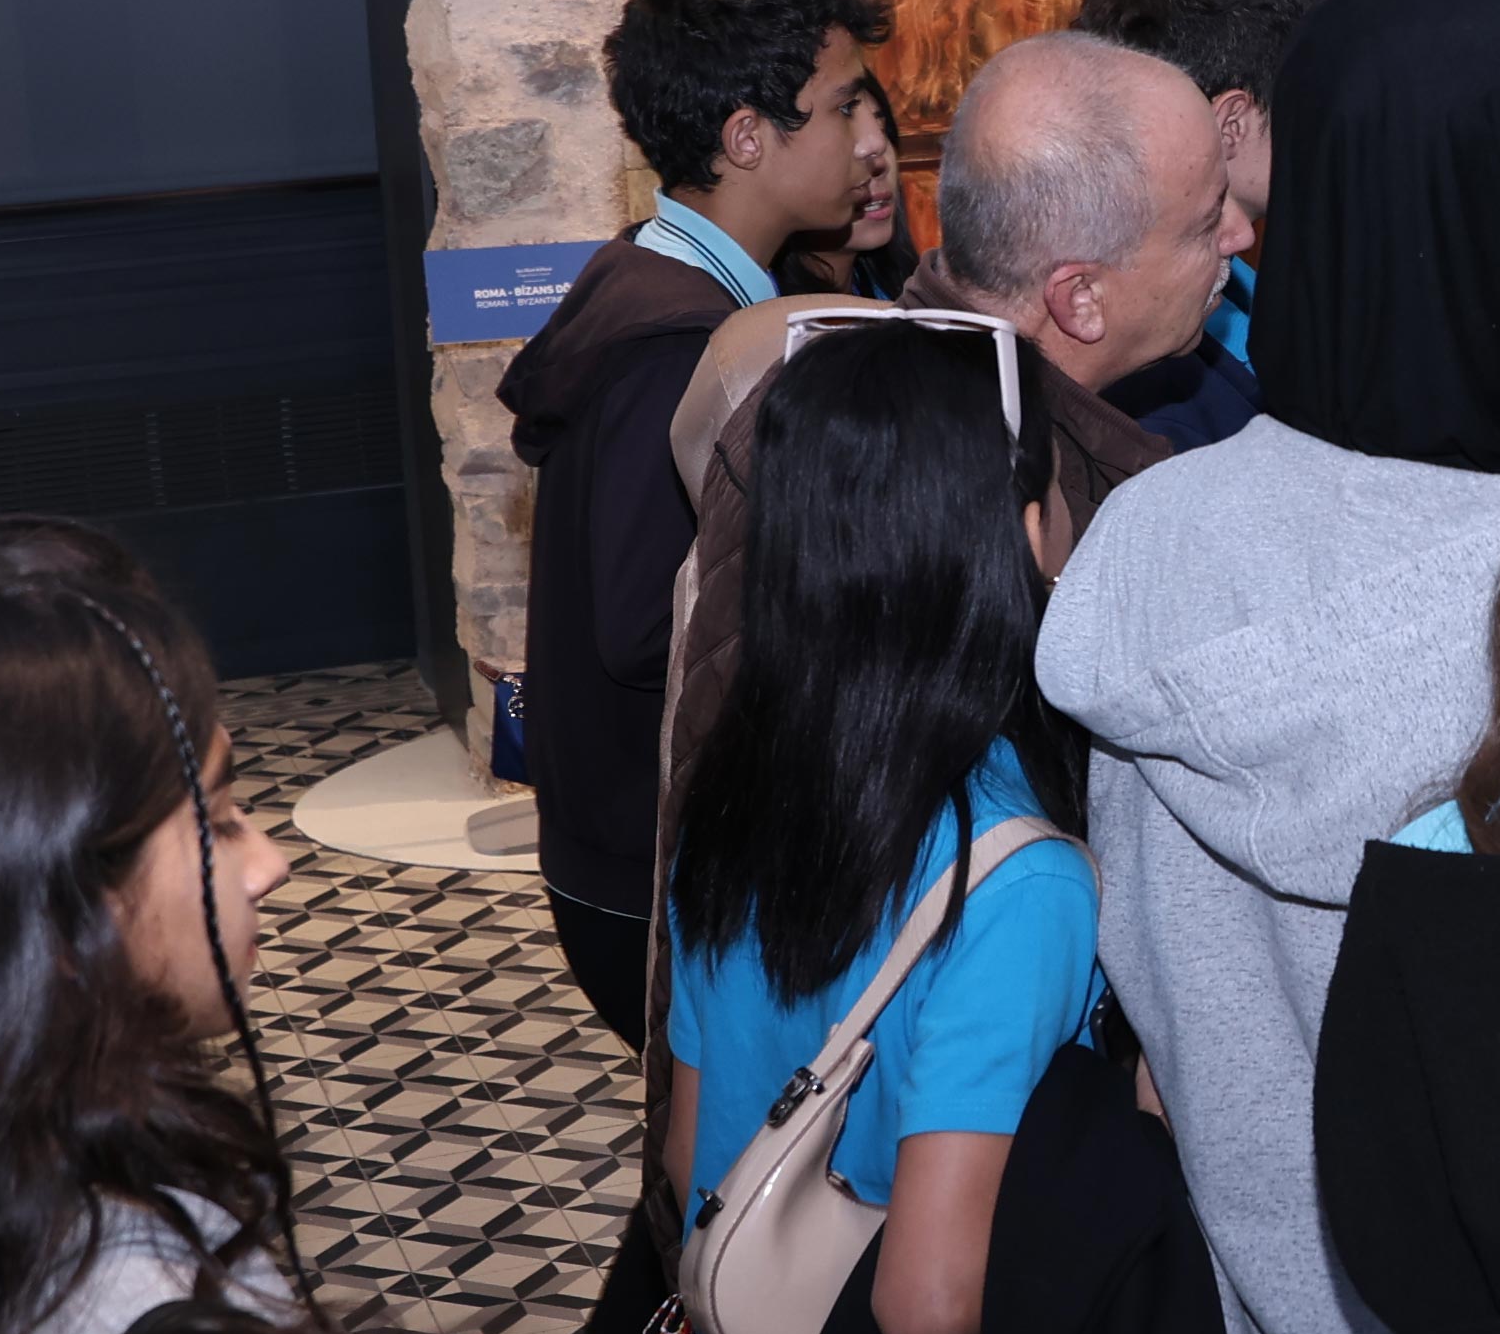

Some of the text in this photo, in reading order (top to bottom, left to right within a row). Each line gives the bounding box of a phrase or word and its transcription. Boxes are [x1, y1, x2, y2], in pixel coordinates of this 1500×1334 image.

[474, 289, 507, 299] ROMA
[514, 284, 554, 296] BİZANS
[476, 299, 509, 309] ROMAN
